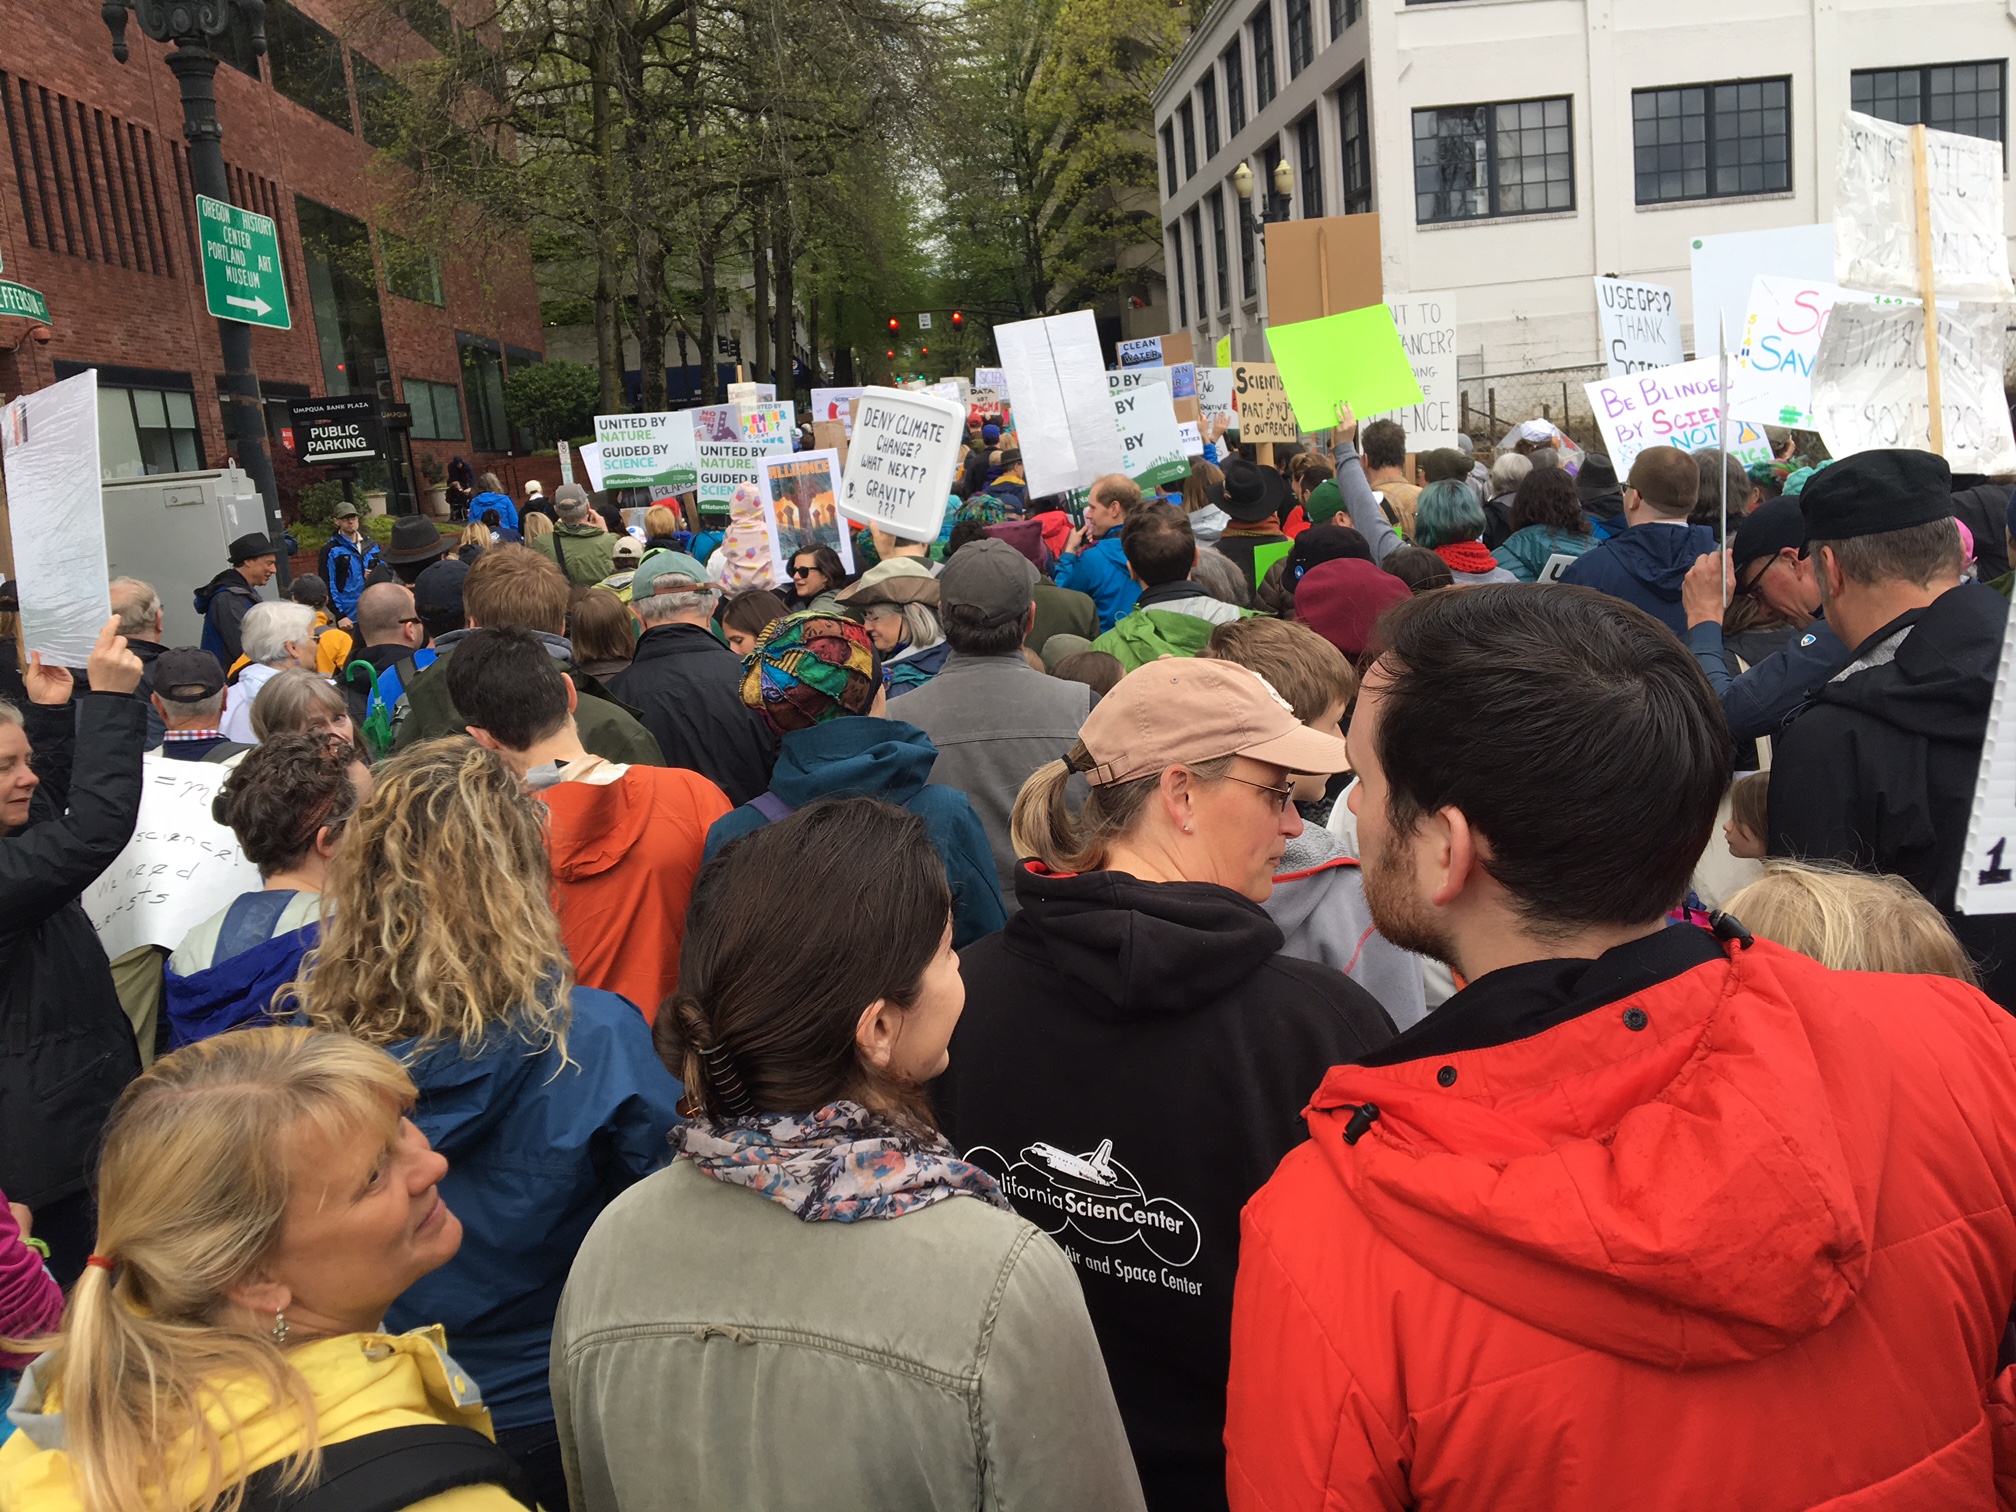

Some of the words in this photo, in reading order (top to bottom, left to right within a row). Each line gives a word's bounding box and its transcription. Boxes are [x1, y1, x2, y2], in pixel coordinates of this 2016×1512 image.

[201, 199, 231, 224] OREGON
[241, 213, 273, 237] HISTORY
[223, 225, 252, 250] CENTER
[207, 240, 246, 267] PORTLAND
[257, 254, 272, 273] ART
[225, 265, 261, 289] MUSEUM
[0, 286, 41, 315] FFERSON
[1602, 284, 1636, 311] USE
[1637, 288, 1672, 316] GPS?
[1418, 303, 1441, 324] TO
[1614, 314, 1667, 344] THANK
[1122, 339, 1156, 351] CLEAN
[1398, 328, 1455, 356] ANCER?
[1123, 350, 1159, 363] WATER
[1123, 373, 1142, 387] BY
[1235, 367, 1284, 394] SCIENTIS
[293, 405, 324, 414] UMPQUA
[326, 403, 345, 411] BANK
[347, 401, 369, 409] PLAZA
[970, 401, 1000, 413] DOGMA
[1114, 396, 1135, 415] BY
[1241, 402, 1264, 418] PART
[1600, 387, 1637, 418] BE
[310, 424, 360, 439] PUBLIC
[599, 417, 648, 430] UNITED
[650, 416, 667, 428] BY
[864, 407, 896, 431] DENY
[895, 414, 945, 443] CLIMATE
[1243, 423, 1250, 436] IS
[1254, 421, 1295, 437] OUTREACH
[1615, 421, 1643, 443] BY
[307, 436, 367, 452] PARKING
[600, 430, 656, 442] NATURE.
[1124, 433, 1144, 451] BY
[1670, 423, 1717, 450] NOT
[602, 445, 650, 458] GUIDED
[653, 444, 669, 455] BY
[700, 446, 748, 457] UNITED
[751, 447, 767, 457] BY
[876, 434, 922, 459] CHANGE?
[603, 457, 658, 471] SCIENCE.
[700, 458, 755, 469] NATURE.
[767, 459, 830, 479] ALLIANCE
[860, 453, 883, 472] WHAT
[887, 460, 927, 484] NEXT?
[700, 473, 748, 484] GUIDED
[750, 474, 759, 484] B
[700, 485, 736, 496] SCIEN
[866, 479, 916, 508] GRAVITY
[877, 500, 896, 519] ???
[126, 861, 201, 880] need
[1063, 1243, 1081, 1266] Air
[1085, 1254, 1111, 1276] and
[1115, 1257, 1157, 1284] Space
[1161, 1268, 1203, 1296] Center
